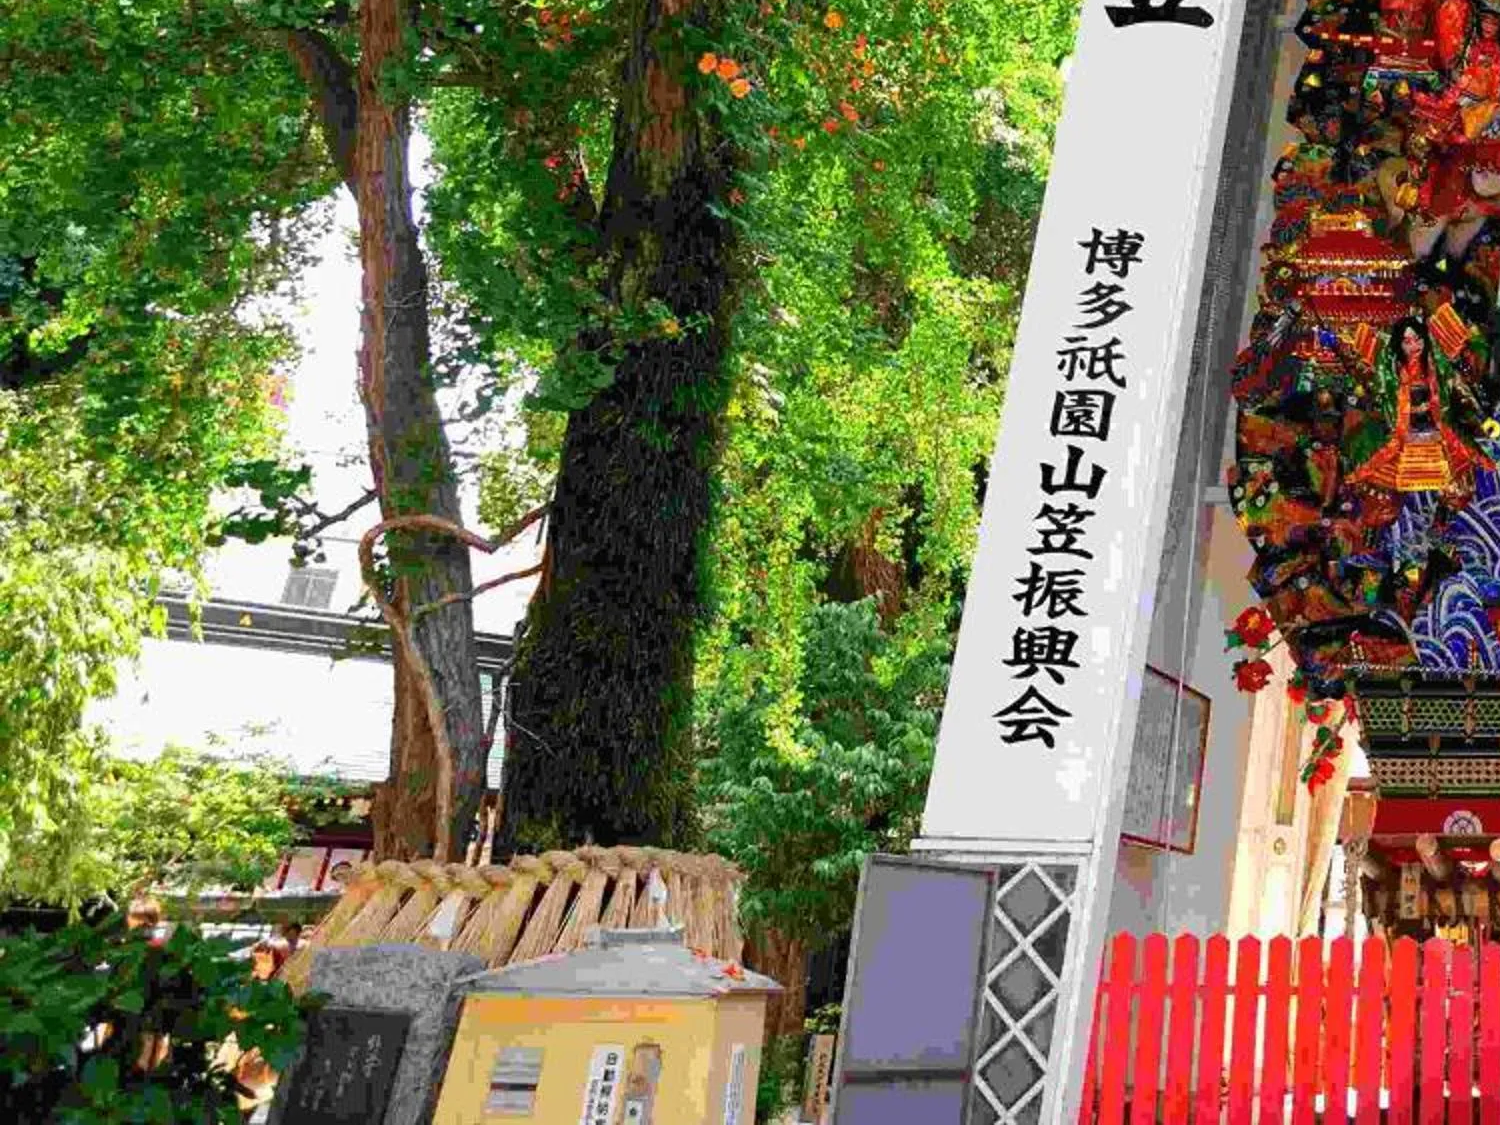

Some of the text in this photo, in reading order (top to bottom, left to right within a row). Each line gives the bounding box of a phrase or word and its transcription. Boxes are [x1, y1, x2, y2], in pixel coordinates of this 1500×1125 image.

[992, 227, 1145, 749] 博多祇園山笠振興会
